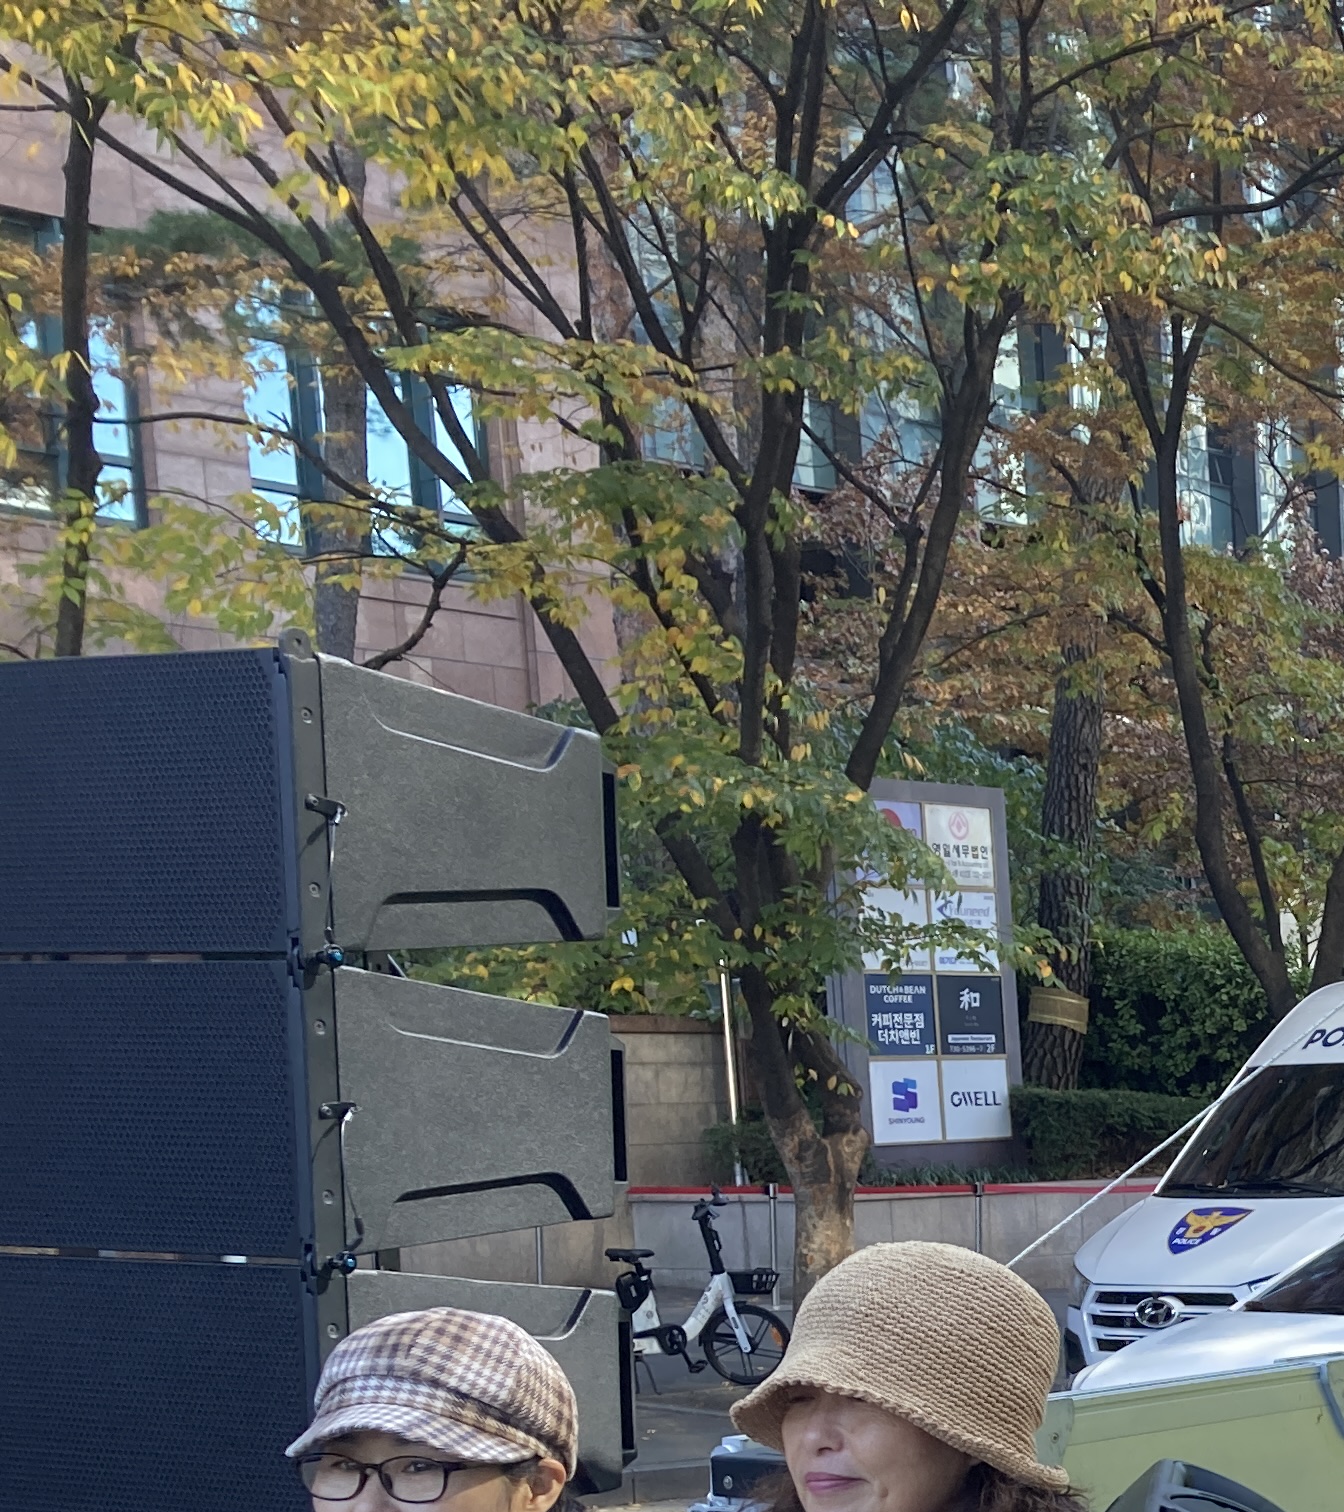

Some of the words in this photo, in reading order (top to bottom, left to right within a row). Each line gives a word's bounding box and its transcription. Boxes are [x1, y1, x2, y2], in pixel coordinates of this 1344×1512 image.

[883, 994, 914, 1004] COFFEE
[959, 987, 981, 1012] 和
[871, 1012, 925, 1029] 커피전문점
[877, 1029, 921, 1045] 더치앤빈
